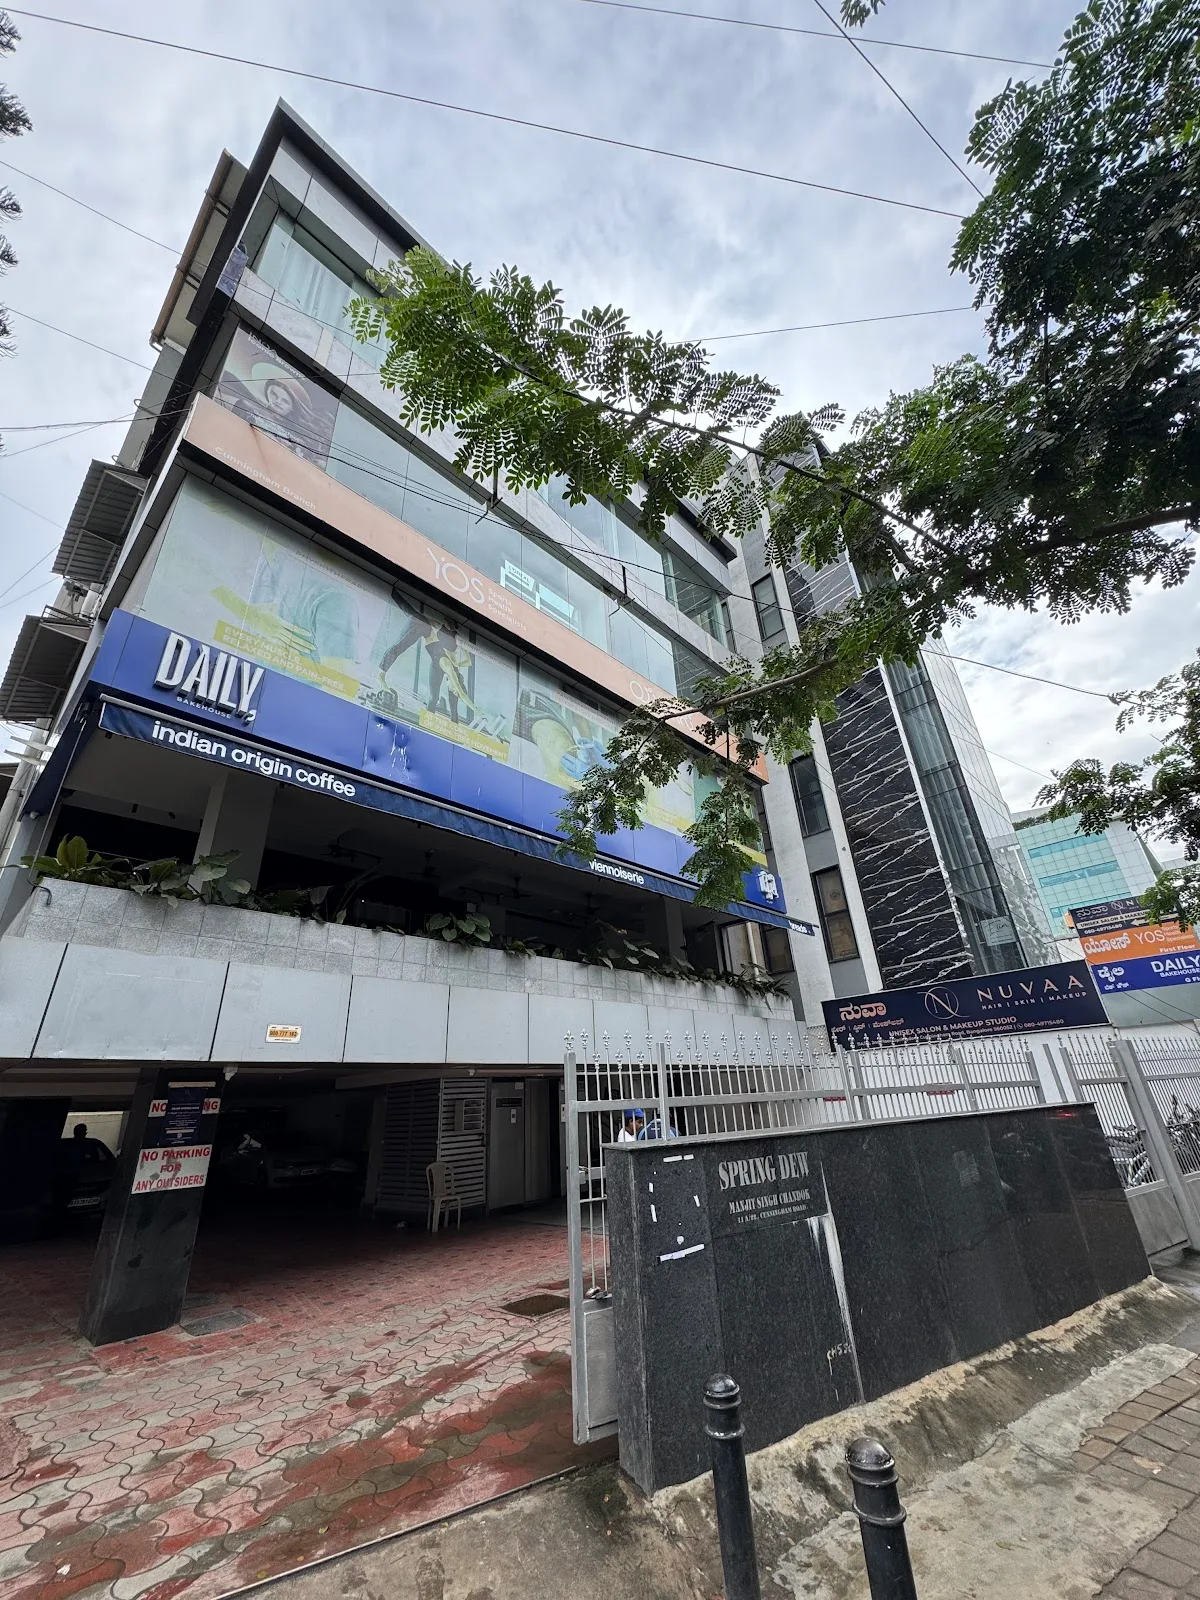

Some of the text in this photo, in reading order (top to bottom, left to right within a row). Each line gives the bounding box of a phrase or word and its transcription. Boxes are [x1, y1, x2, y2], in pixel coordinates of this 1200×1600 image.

[214, 446, 316, 510] Cunningham Branch
[426, 547, 485, 604] YOS
[487, 588, 512, 606] Sports
[488, 596, 513, 614] Health
[487, 603, 528, 632] Specialists
[224, 626, 259, 646] EVERY
[222, 634, 272, 662] RELAXED
[272, 655, 294, 670] AND
[176, 696, 232, 719] BAKEHOUSE
[152, 720, 356, 797] indian origin coffee
[589, 859, 645, 884] viennoiserie
[1076, 905, 1109, 918] ನುವಾ
[1134, 929, 1166, 945] YOS
[1150, 955, 1200, 973] DAILY
[1159, 968, 1200, 978] BAKEHOUSE
[976, 975, 1085, 1003] NUVAA
[1014, 998, 1036, 1006] SKIN
[1048, 991, 1087, 1001] MAKEUP
[838, 1001, 887, 1021] ನುವಾ
[888, 1027, 915, 1036] UNISEX
[915, 1023, 941, 1033] SALON
[949, 1020, 984, 1030] MAKEUP
[984, 1016, 1017, 1026] STUDIO
[151, 1102, 168, 1113] NO
[141, 1147, 211, 1162] NO PARKING
[160, 1164, 182, 1173] FOR
[718, 1151, 809, 1191] SPRING DEW
[134, 1174, 205, 1192] ANY OUTSIDERS
[729, 1189, 811, 1214] MANJIT SINGH CHANDOK
[760, 1207, 792, 1219] CUNNINGHAM
